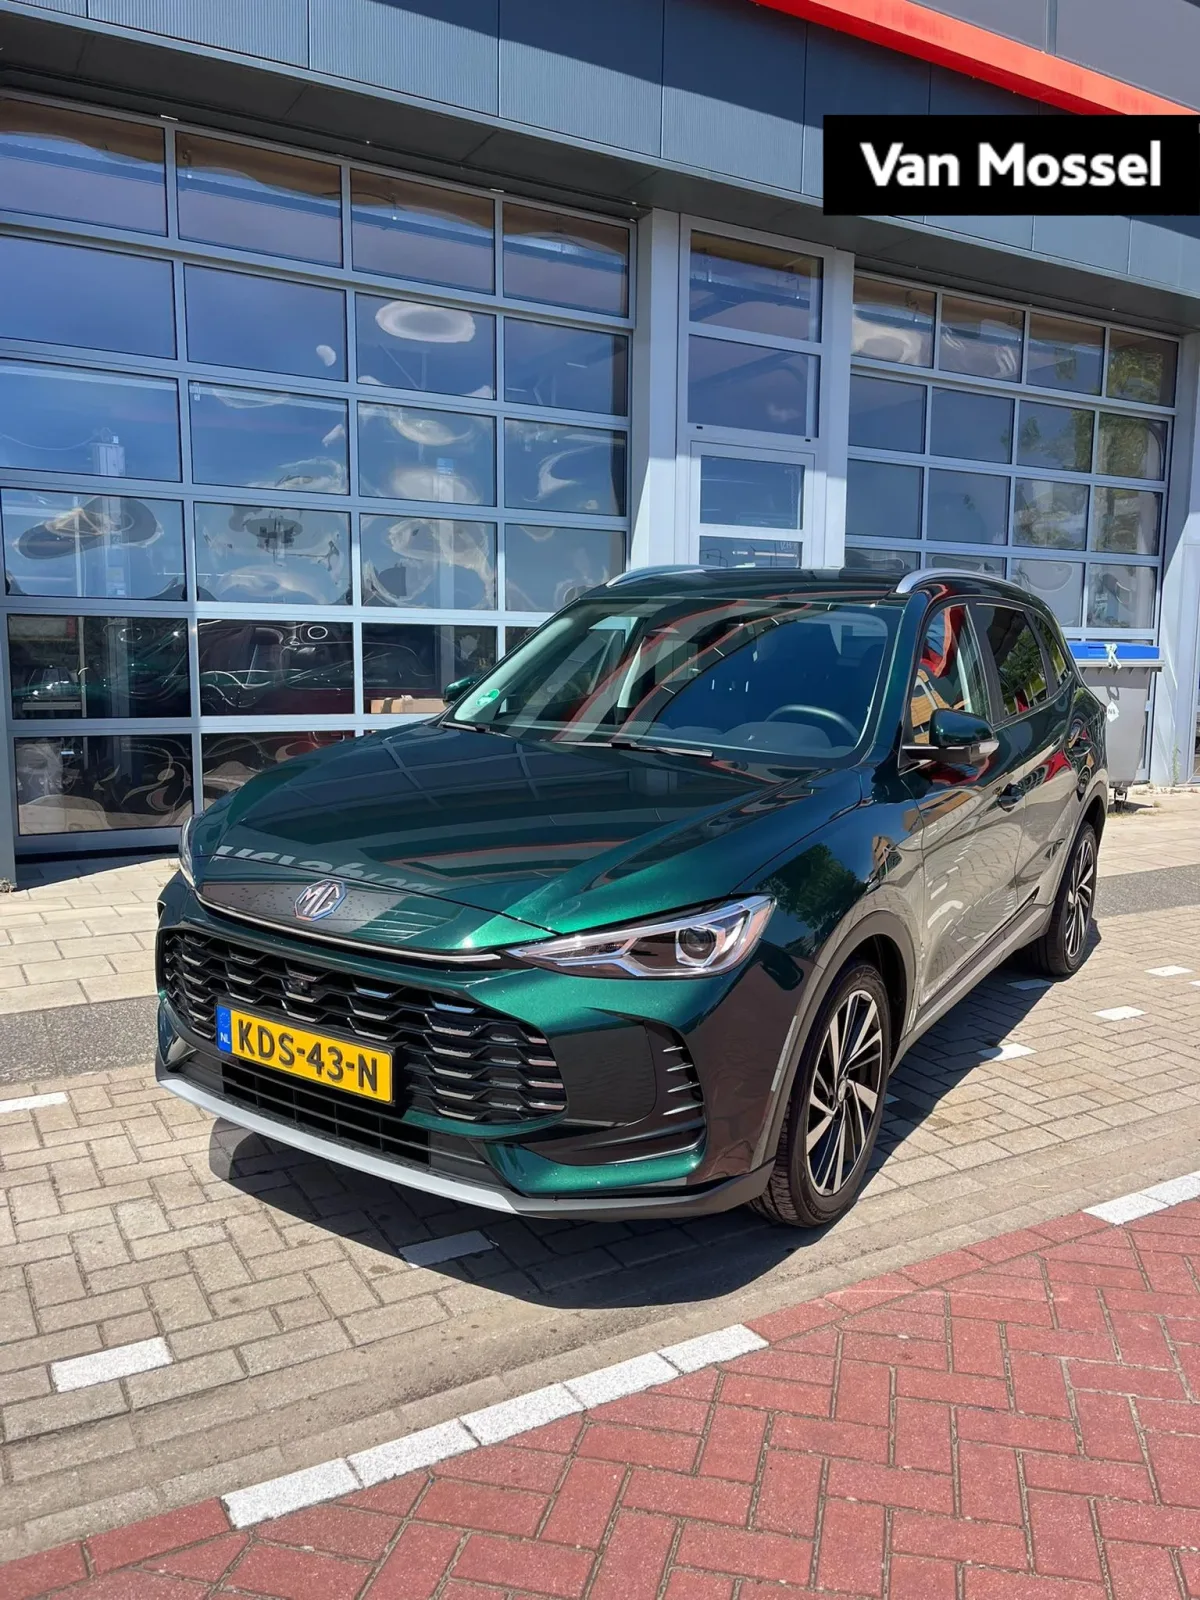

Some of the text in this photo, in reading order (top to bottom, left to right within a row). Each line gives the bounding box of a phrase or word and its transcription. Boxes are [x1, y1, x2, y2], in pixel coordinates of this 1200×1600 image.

[298, 882, 340, 917] MG
[220, 1032, 231, 1044] NL
[238, 1018, 378, 1093] KDS-43-N
